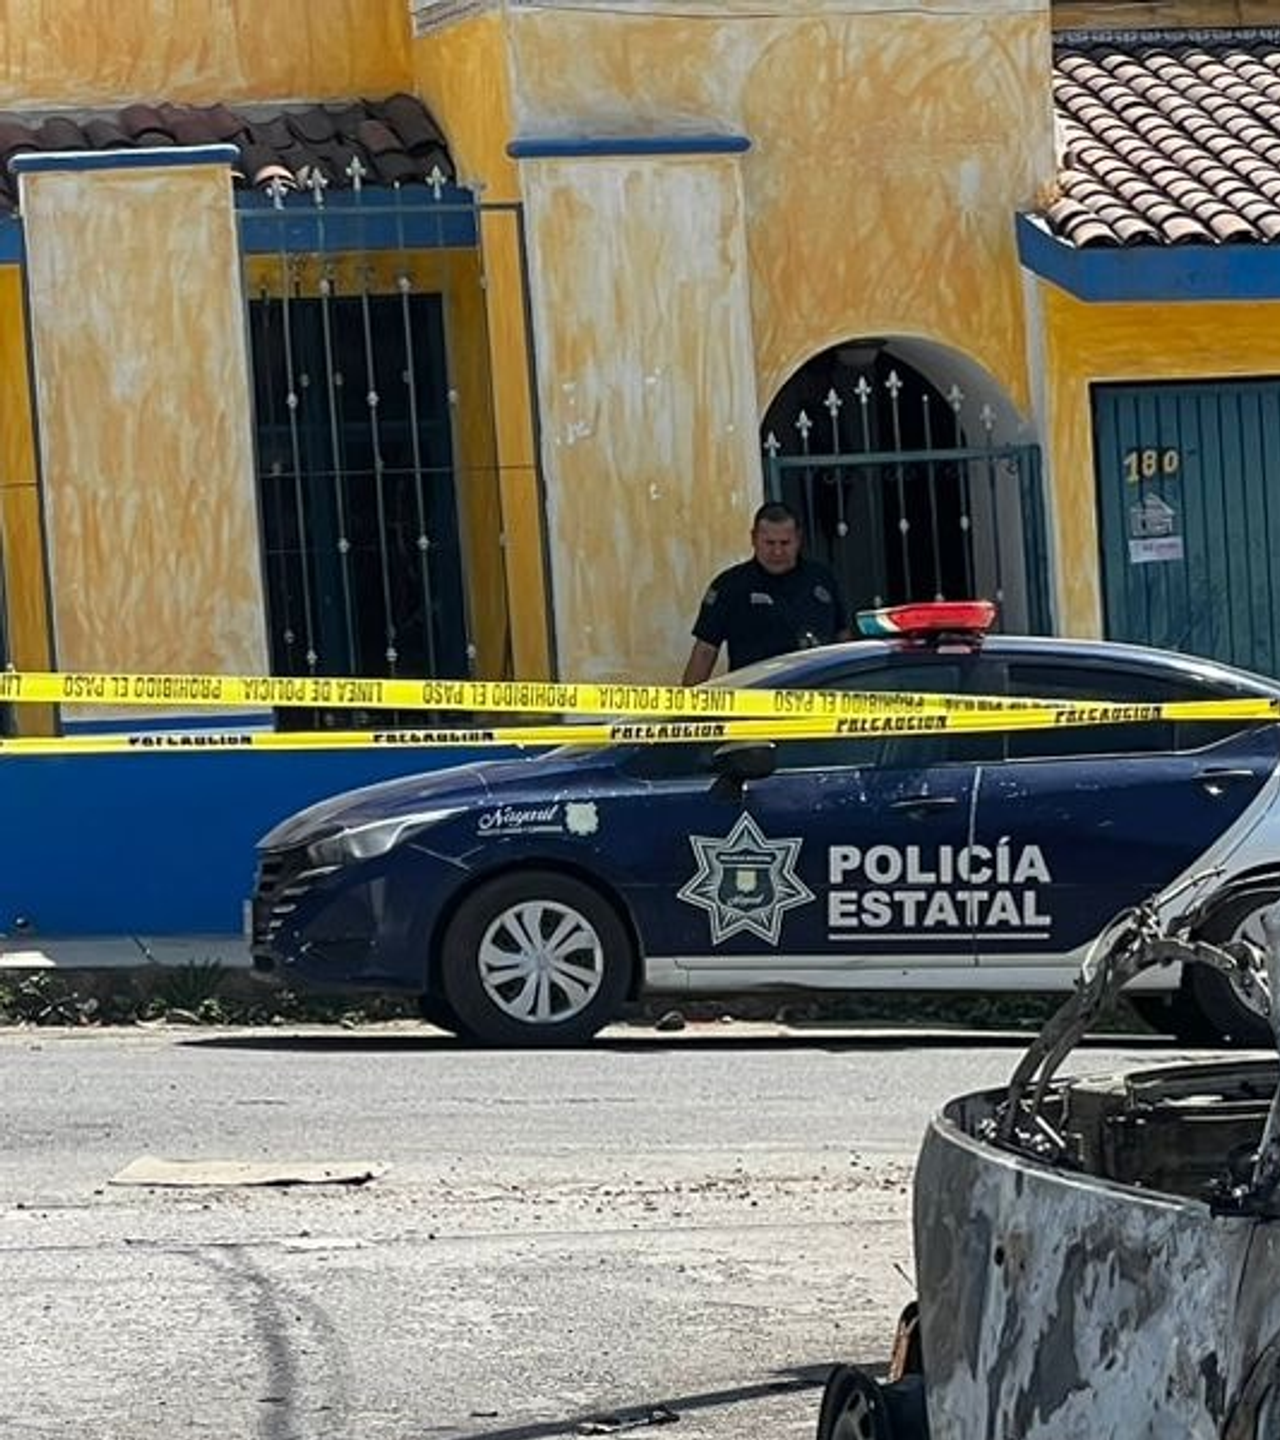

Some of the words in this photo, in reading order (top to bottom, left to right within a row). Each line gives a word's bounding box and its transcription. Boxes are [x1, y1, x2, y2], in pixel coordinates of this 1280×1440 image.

[1122, 449, 1179, 483] 180
[63, 676, 105, 697] PASO
[112, 677, 128, 697] EL
[134, 677, 223, 699] PROHIBIDO
[310, 680, 332, 701] DE
[422, 682, 465, 705] PASO
[469, 683, 487, 706] EL
[493, 684, 578, 708] PROHIBIDO
[599, 687, 660, 710] POLICIA
[664, 688, 686, 711] DE
[691, 689, 735, 712] LINEA
[774, 690, 815, 713] PASO
[817, 691, 837, 713] EL
[829, 836, 1051, 884] POLICÍA
[828, 891, 1051, 927] ESTATAL
